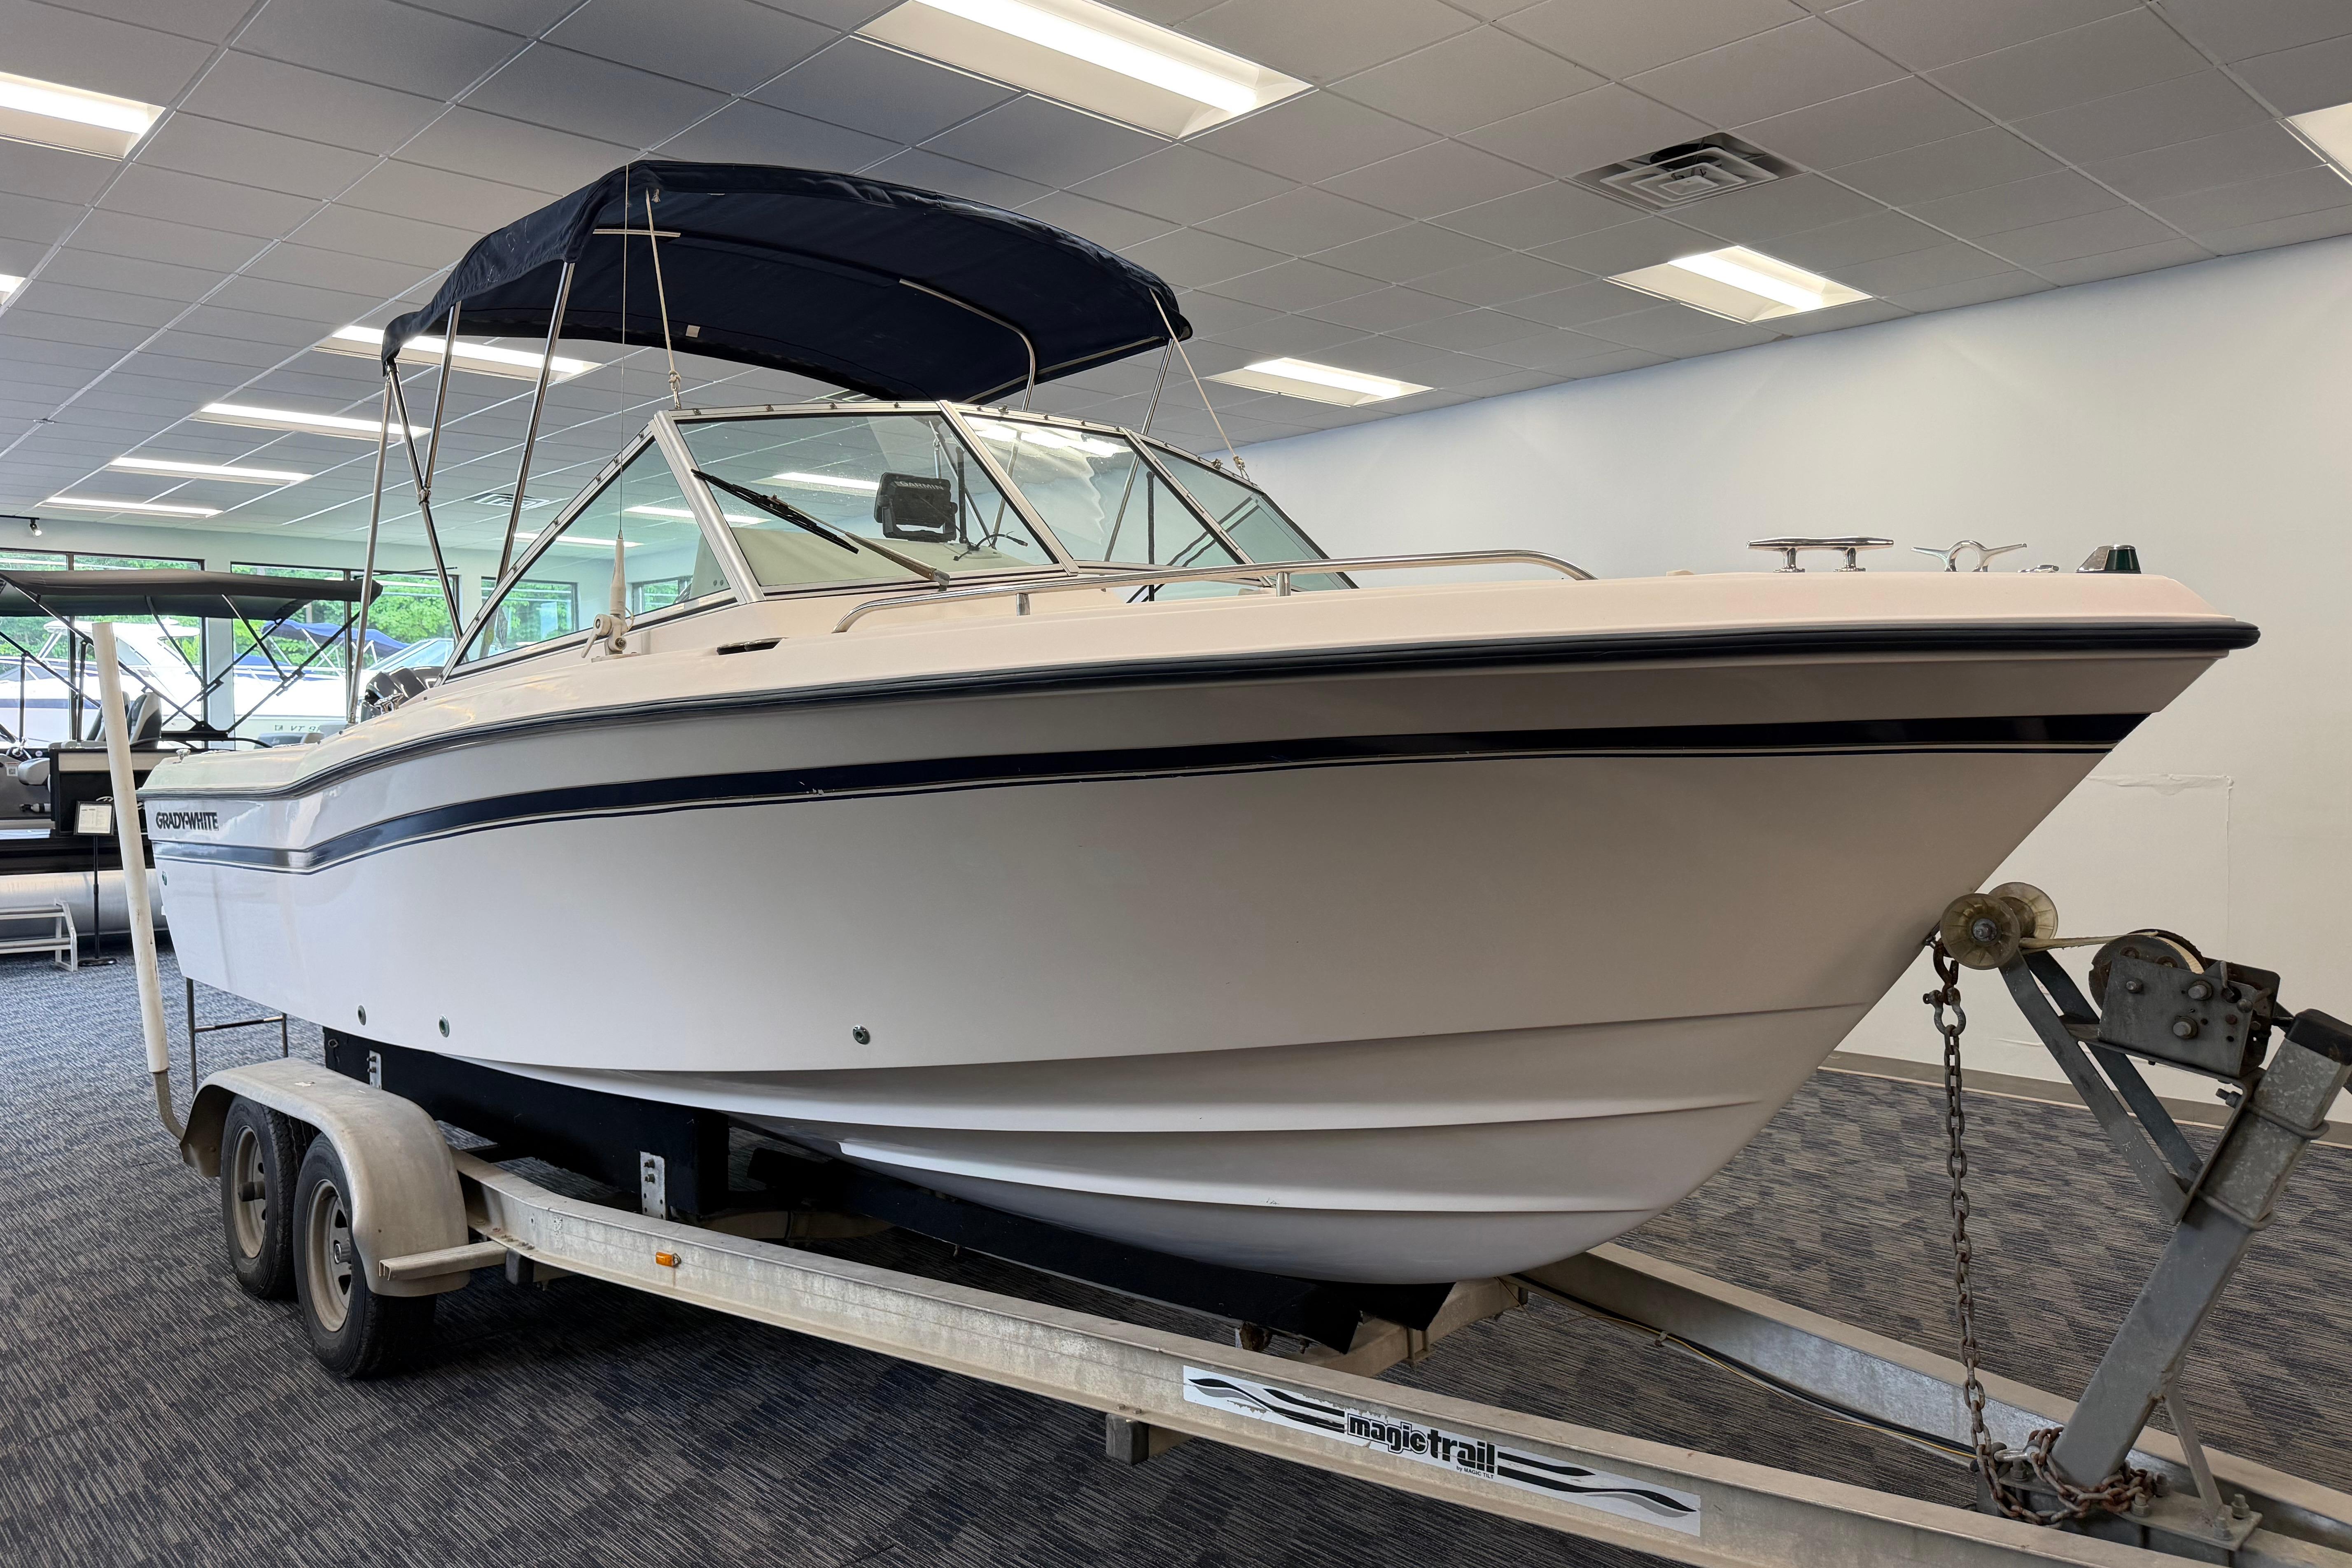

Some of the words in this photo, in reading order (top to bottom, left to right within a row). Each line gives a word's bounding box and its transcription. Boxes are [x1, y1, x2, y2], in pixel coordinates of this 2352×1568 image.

[899, 481, 945, 490] GARMIN
[155, 811, 219, 831] GRADY-WHITE
[1464, 1468, 1482, 1476] MAGIC
